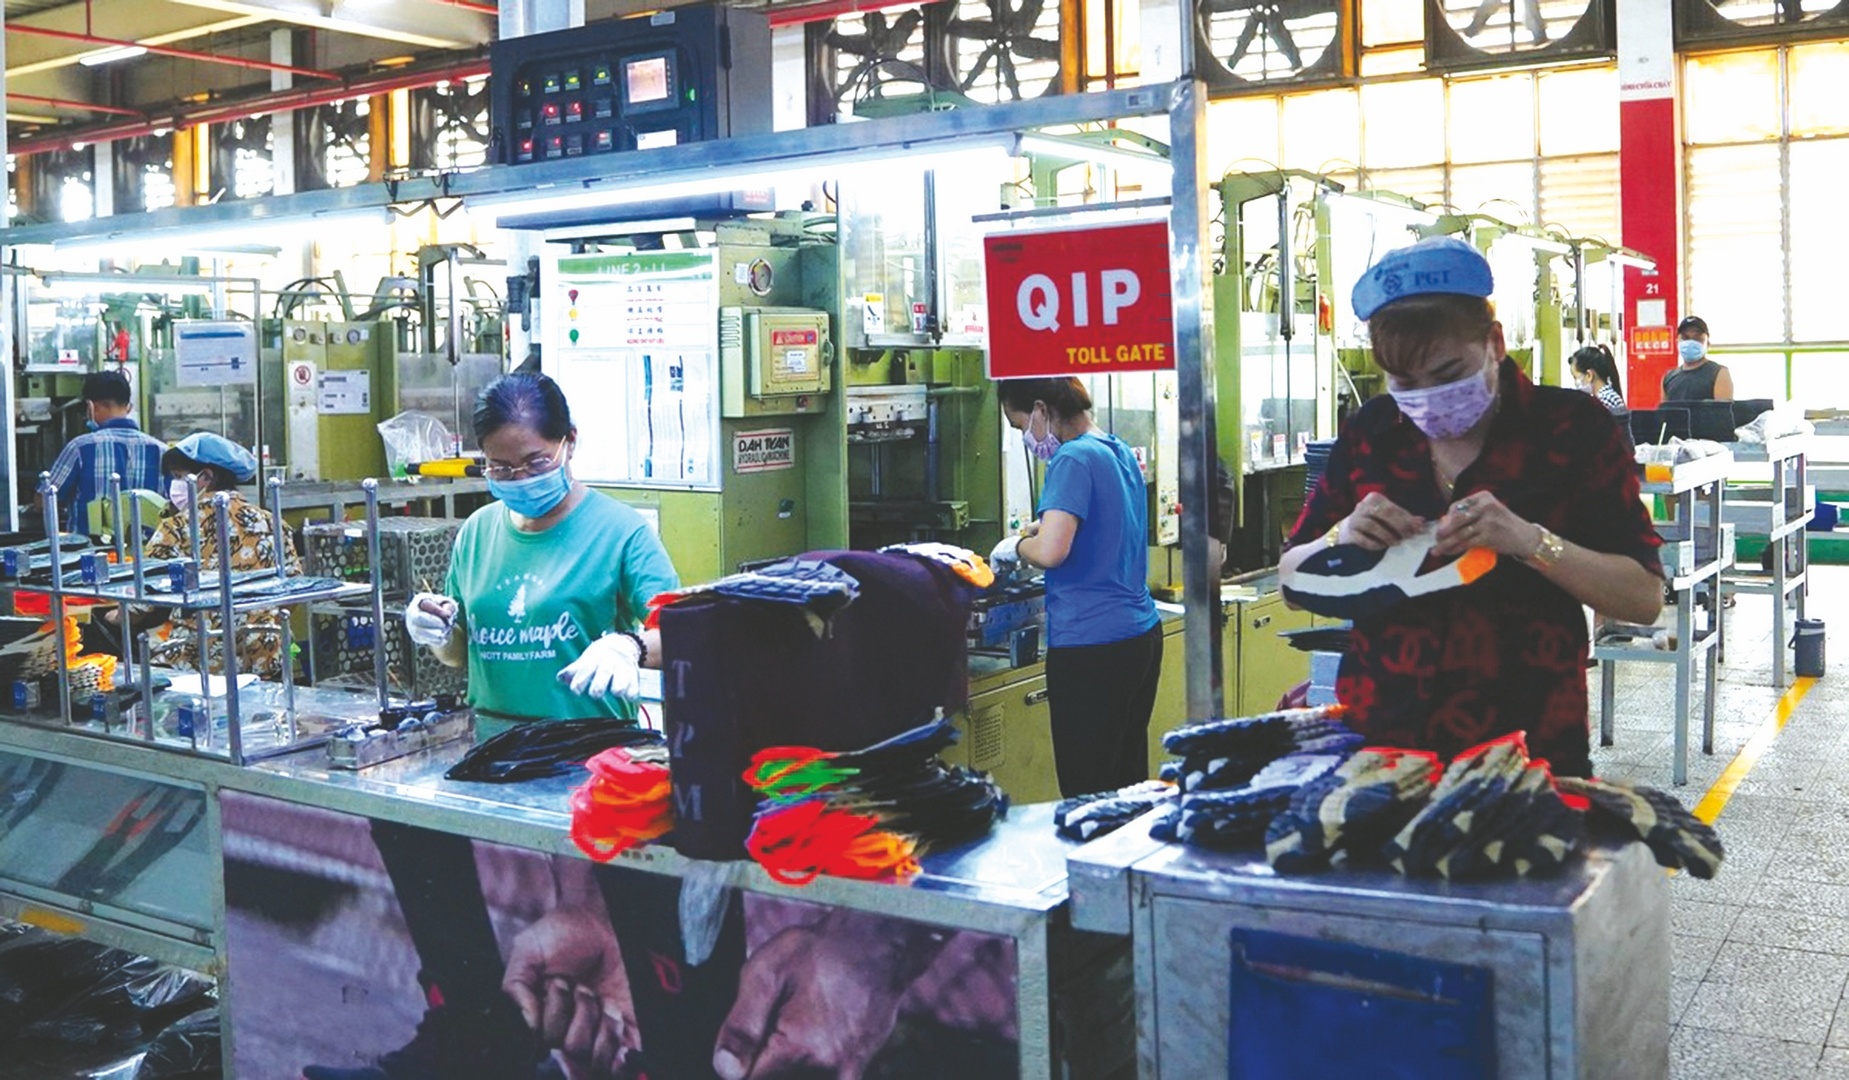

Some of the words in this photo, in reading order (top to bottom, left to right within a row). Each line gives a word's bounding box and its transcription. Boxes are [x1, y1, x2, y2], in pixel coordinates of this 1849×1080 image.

[1415, 270, 1451, 286] PGT
[1646, 283, 1659, 294] 21
[1017, 268, 1141, 334] QIP
[1066, 347, 1111, 364] TOLL
[1116, 344, 1165, 362] GATE
[519, 611, 579, 649] maple
